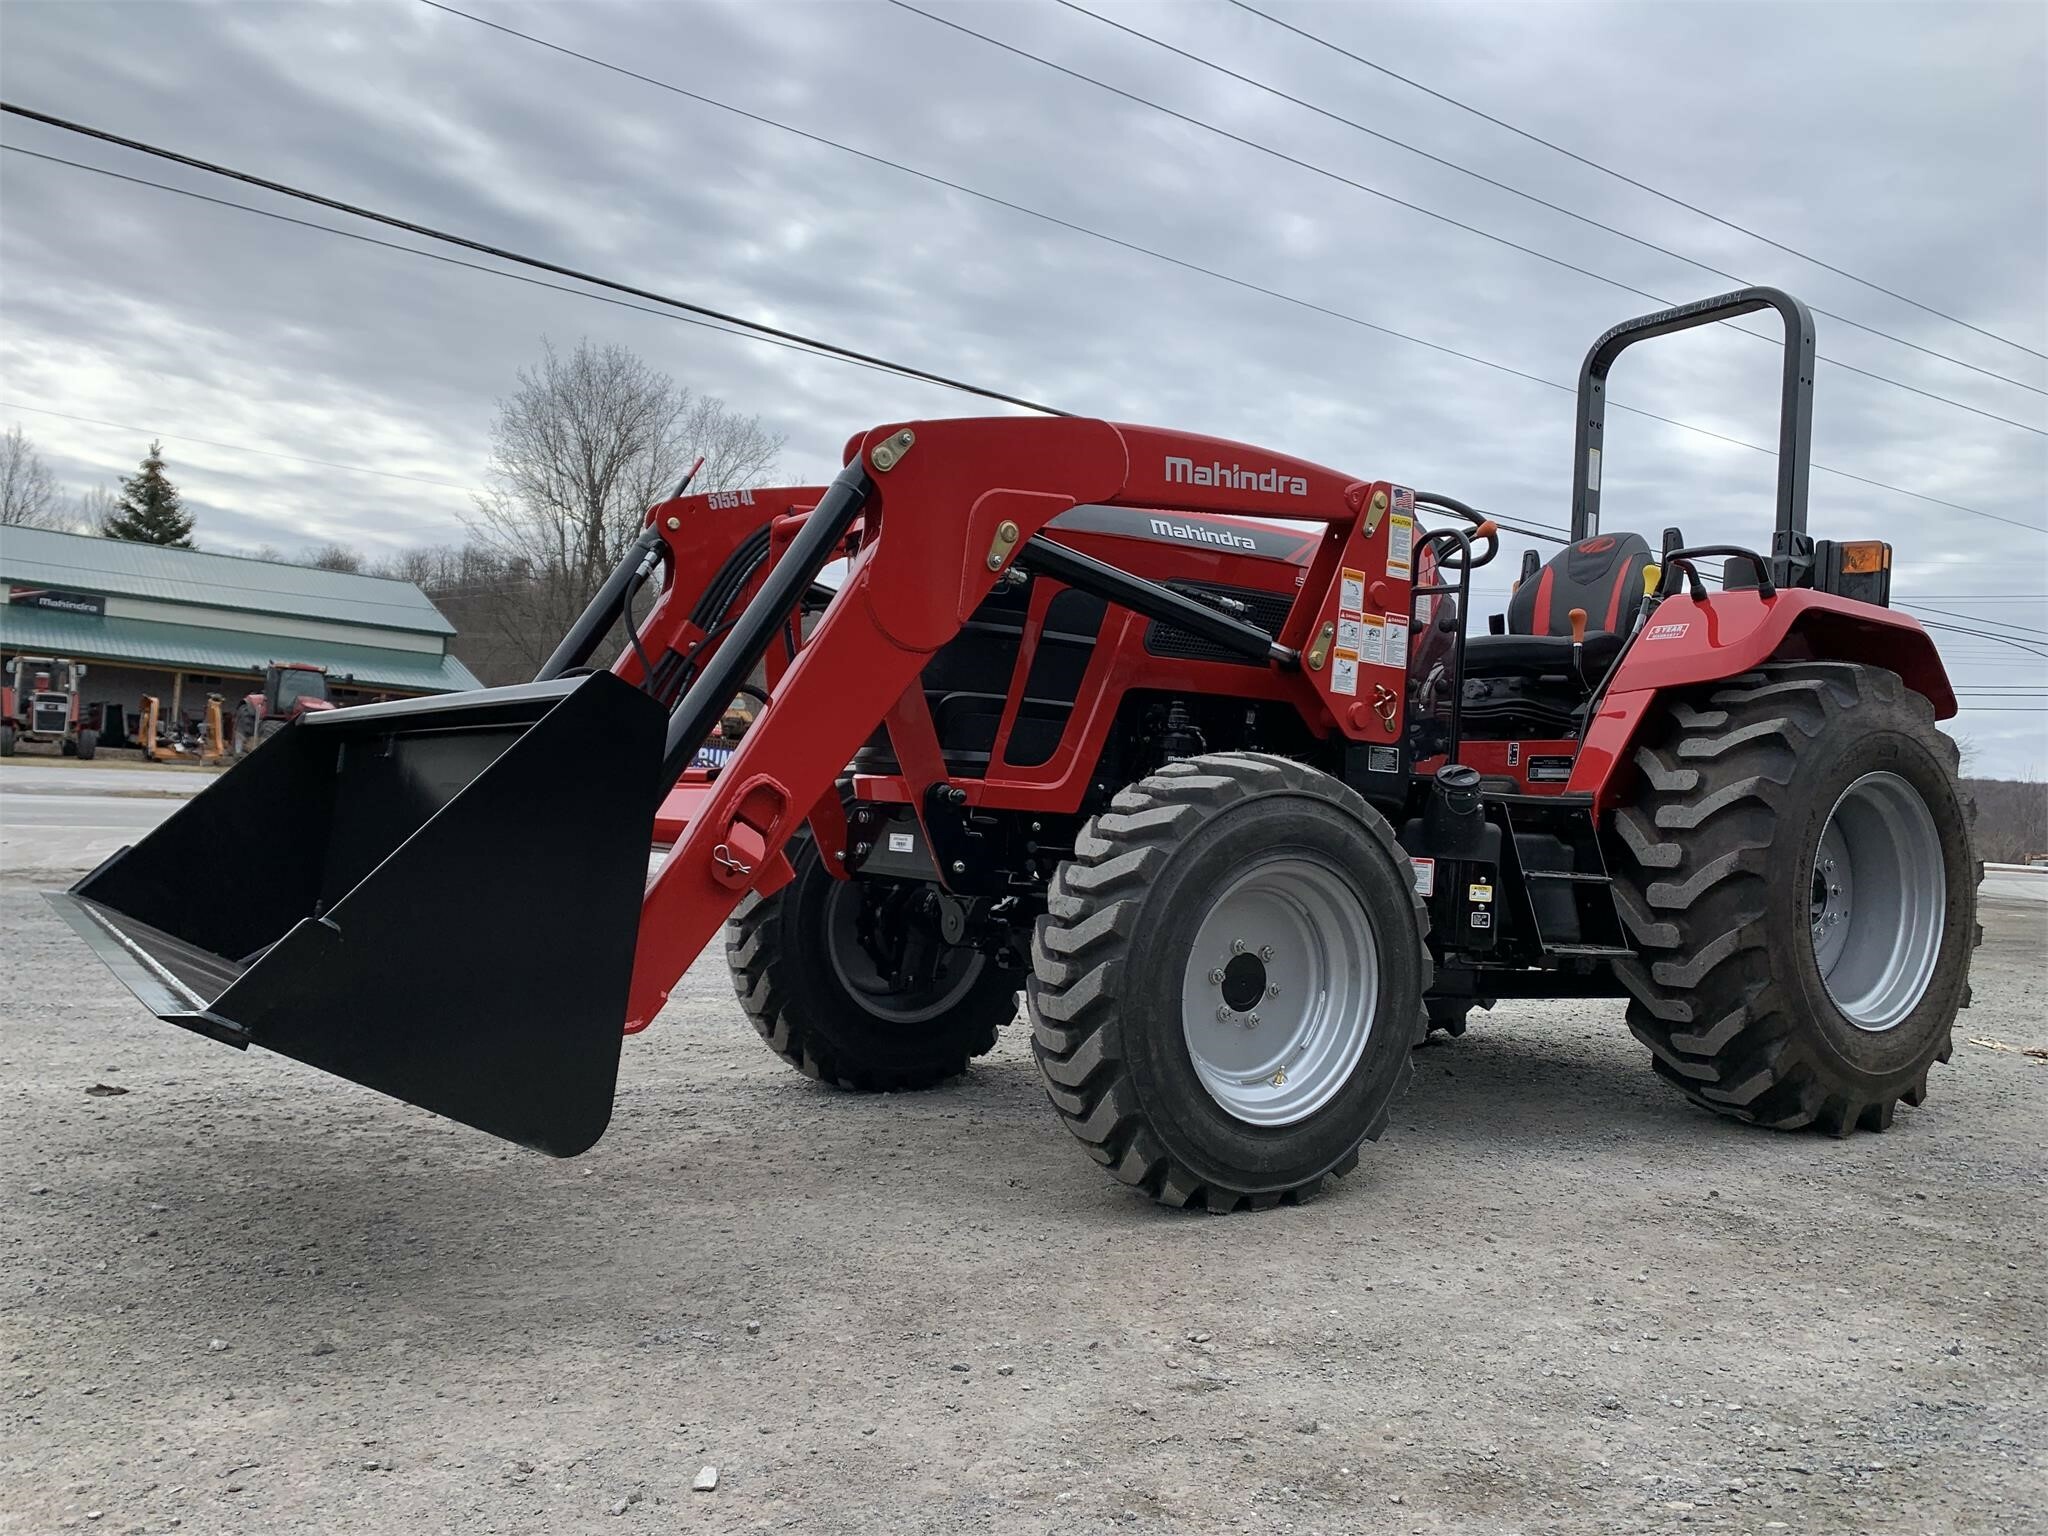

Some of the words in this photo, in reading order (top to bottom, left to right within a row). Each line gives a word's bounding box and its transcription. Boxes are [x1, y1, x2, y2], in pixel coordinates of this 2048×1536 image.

[1165, 456, 1307, 496] Mahindra
[708, 492, 739, 511] 5155
[740, 489, 756, 506] 4L
[1150, 519, 1257, 550] Mahindra
[39, 597, 98, 612] Mahindra
